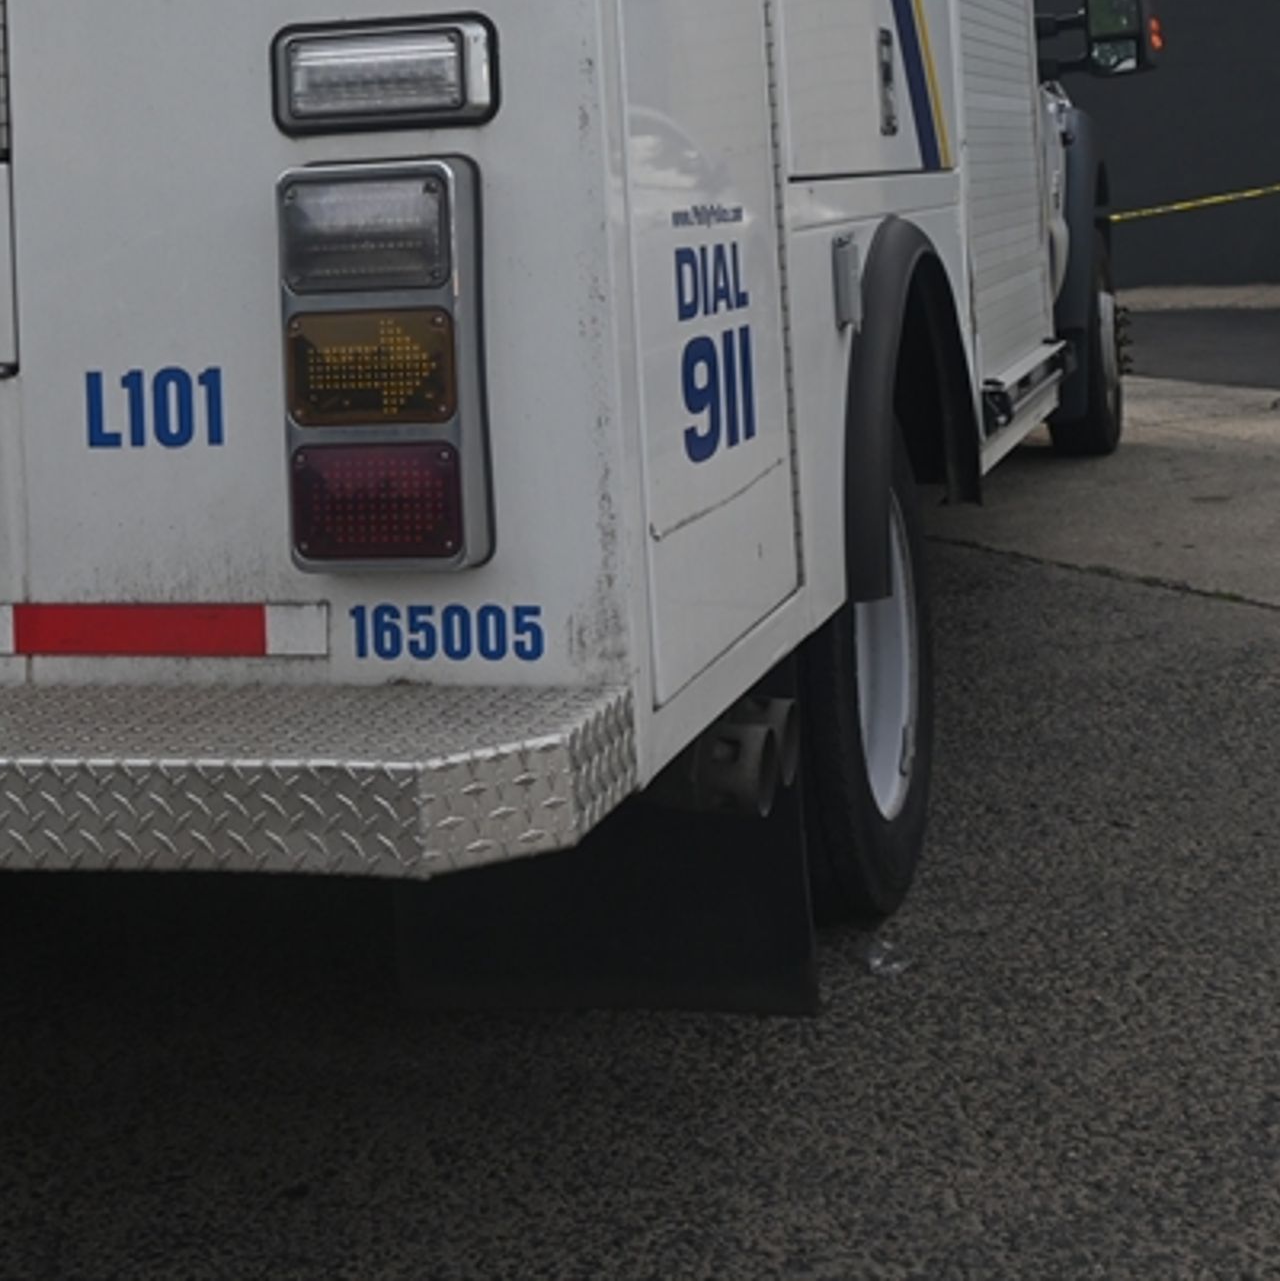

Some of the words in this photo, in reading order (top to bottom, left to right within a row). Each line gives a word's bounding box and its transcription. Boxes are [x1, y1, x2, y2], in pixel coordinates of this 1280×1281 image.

[675, 240, 749, 321] DIAL
[85, 366, 225, 448] L101
[681, 324, 756, 463] 911
[349, 603, 545, 661] 165005
